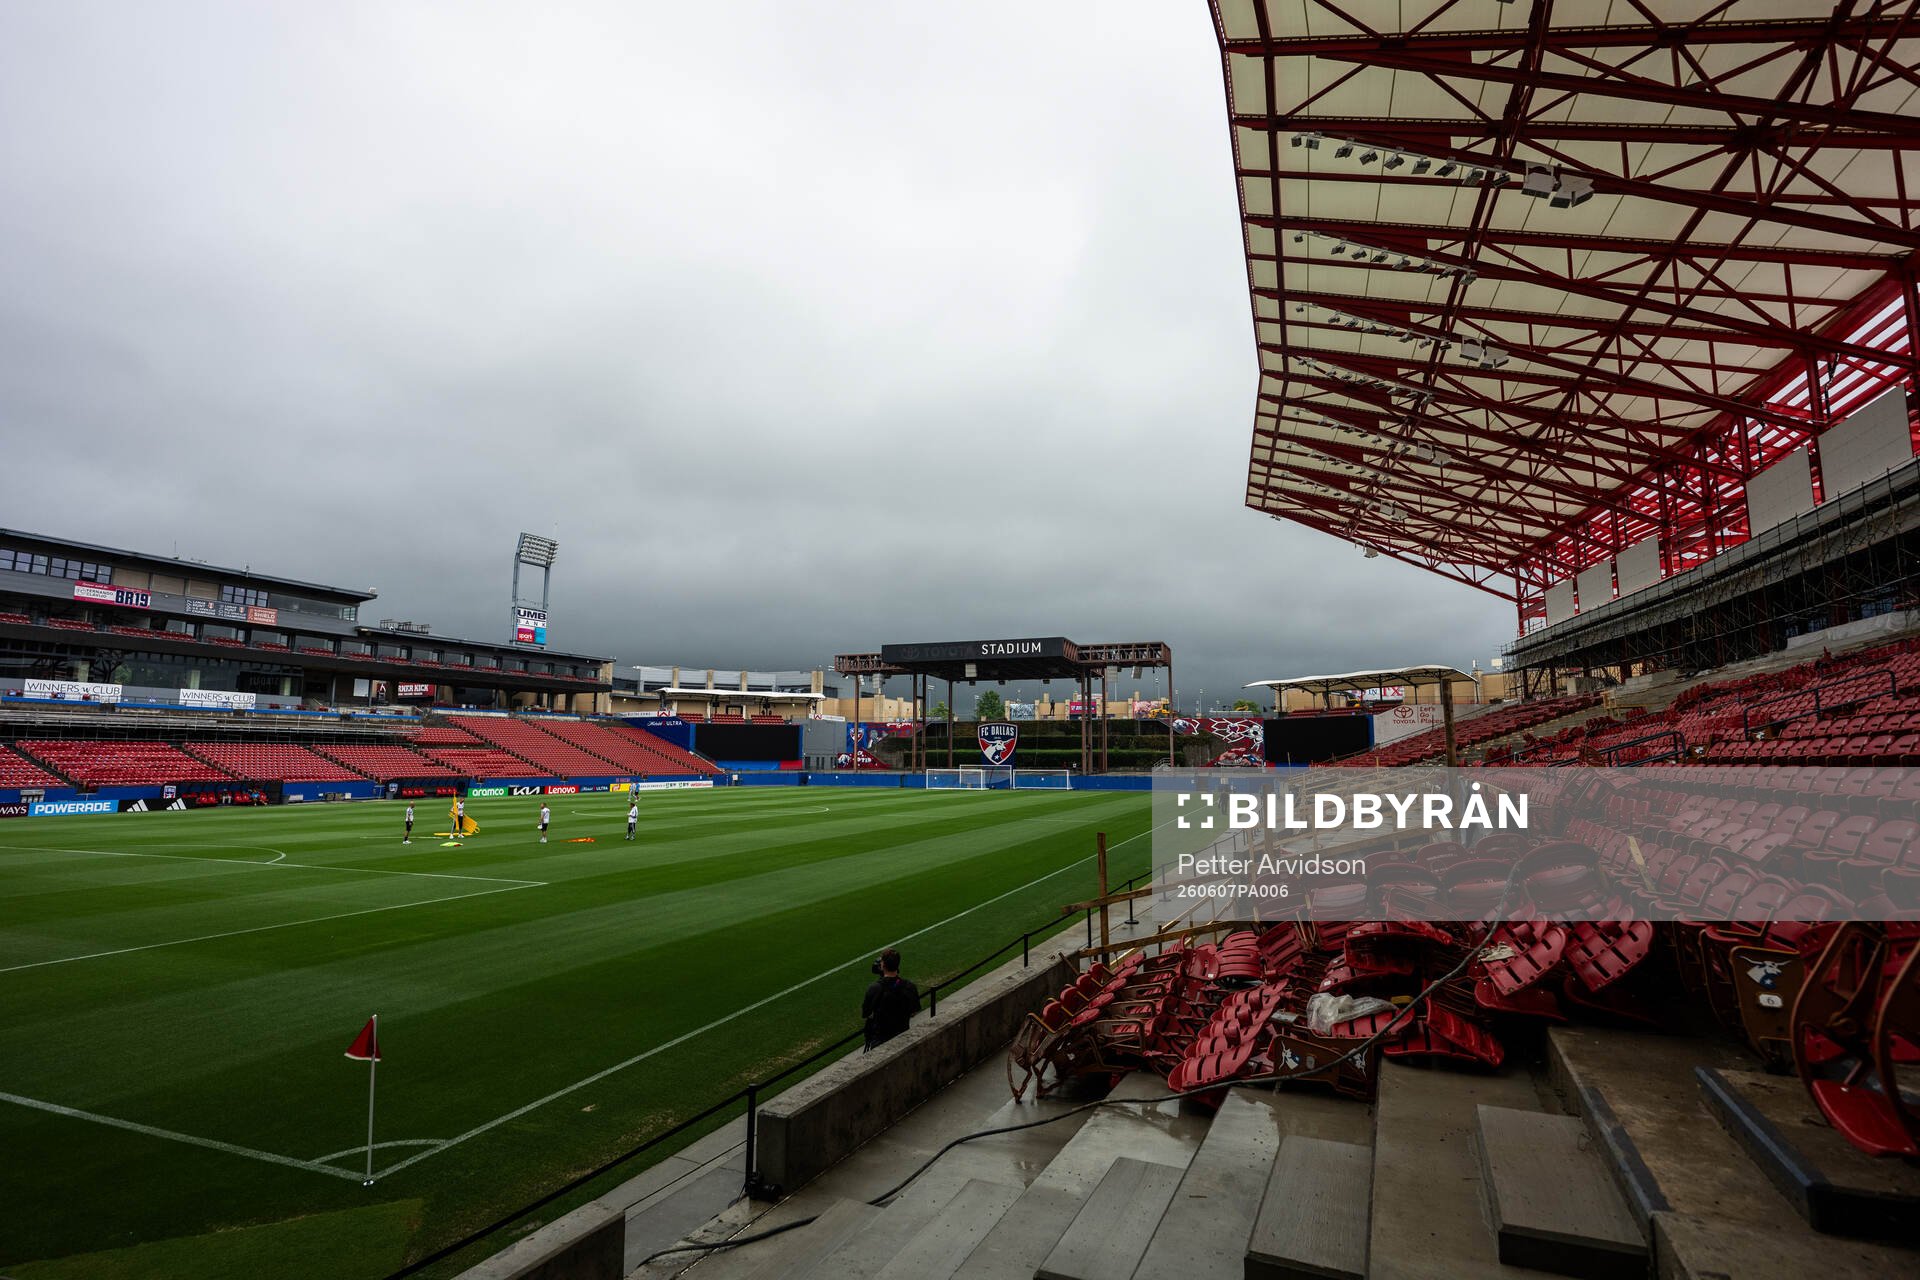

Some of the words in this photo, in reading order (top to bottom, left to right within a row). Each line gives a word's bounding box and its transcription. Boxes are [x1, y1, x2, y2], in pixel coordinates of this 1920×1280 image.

[115, 589, 149, 607] BR19
[517, 609, 546, 620] UMB
[981, 641, 1042, 655] STADIUM
[27, 682, 80, 694] WINNERS
[92, 685, 121, 695] CLUB
[181, 690, 223, 701] WINNERS
[232, 694, 256, 703] CLUB
[981, 727, 989, 737] FC
[991, 725, 1015, 737] DALLAS
[472, 787, 504, 796] aramco
[548, 785, 576, 795] Lenovo
[34, 802, 112, 815] POWERADE
